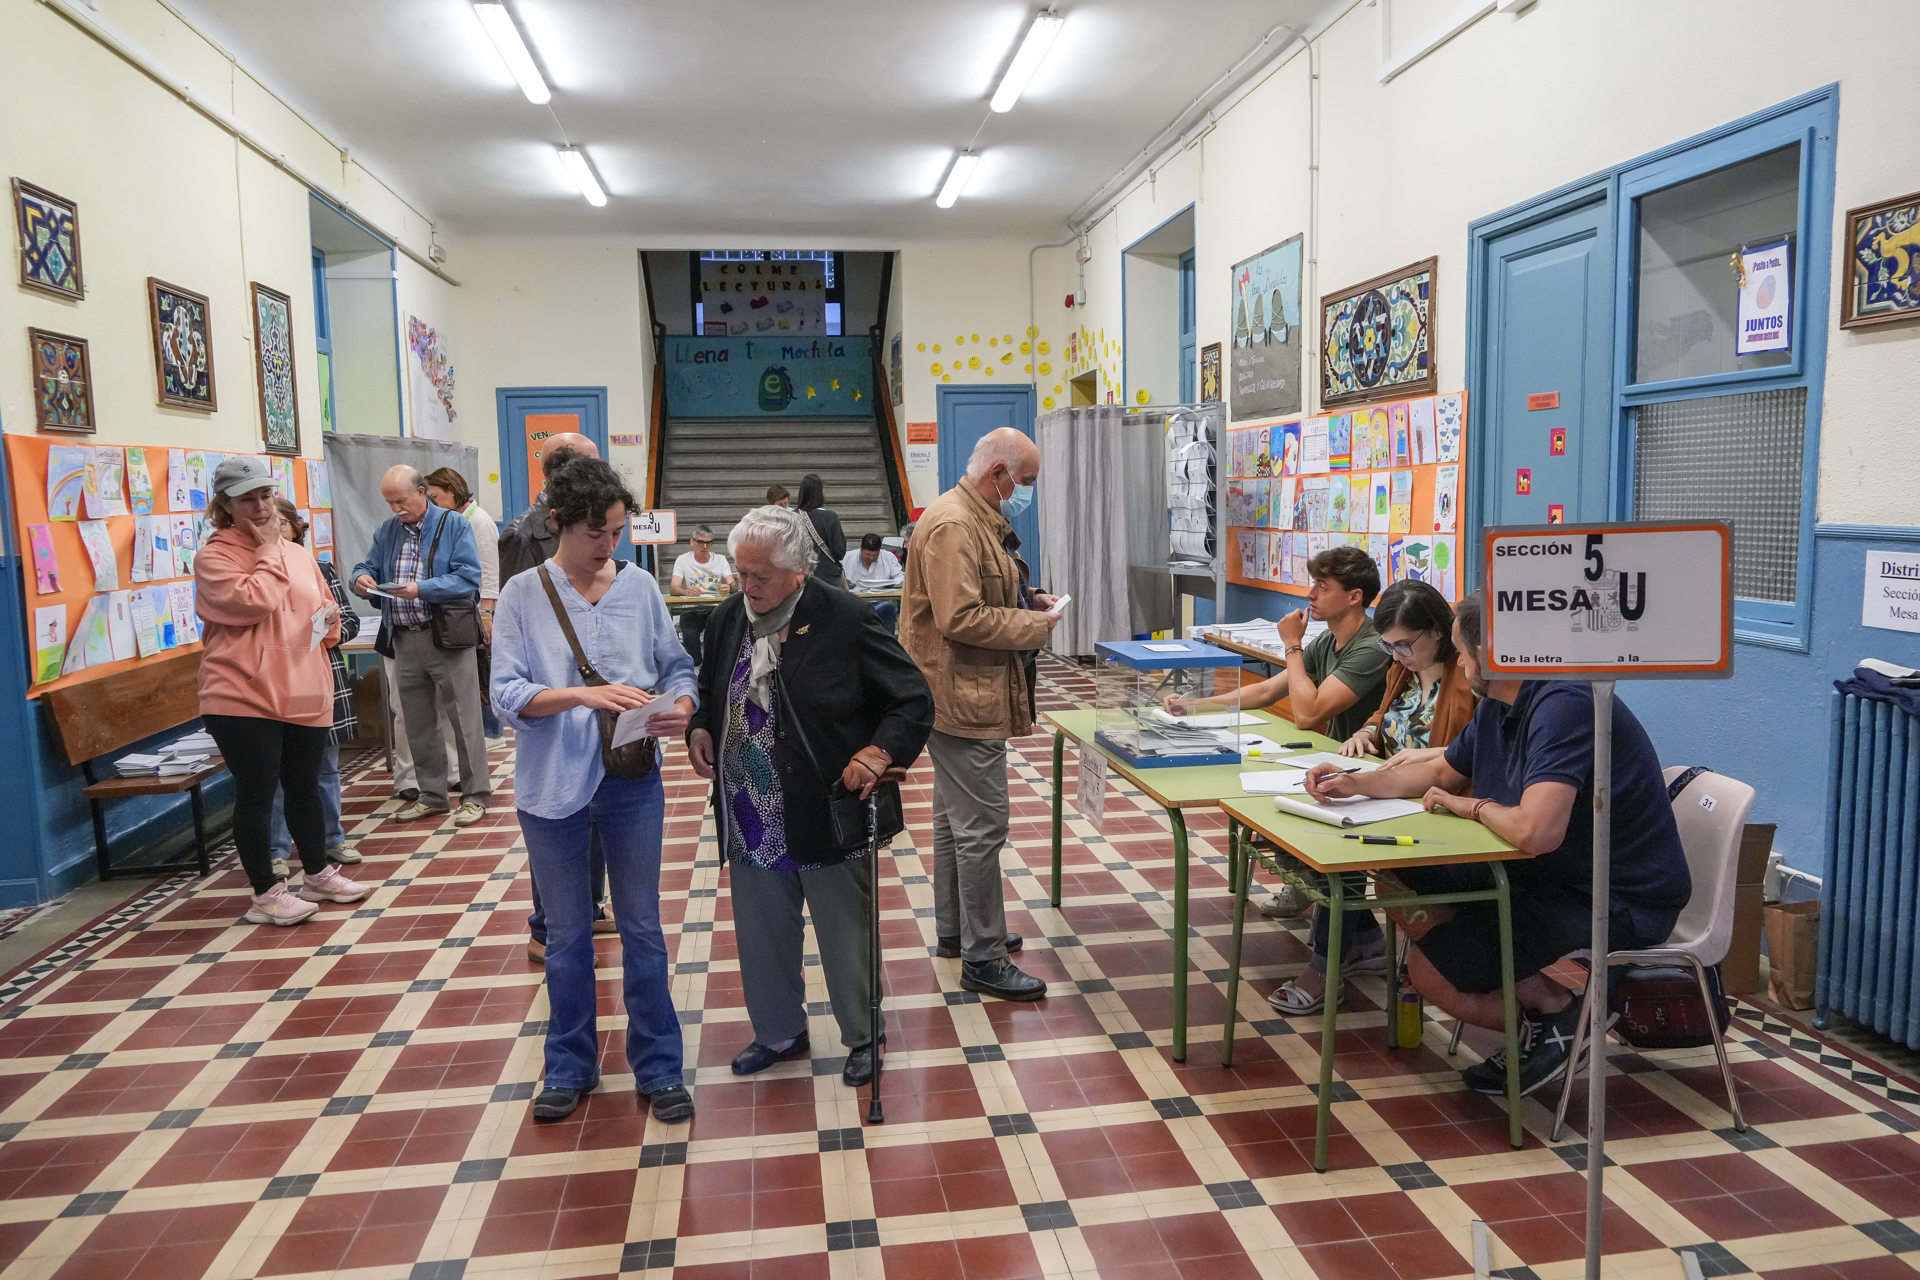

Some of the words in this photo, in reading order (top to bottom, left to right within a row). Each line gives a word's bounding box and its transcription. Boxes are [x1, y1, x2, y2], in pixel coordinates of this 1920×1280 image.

[720, 263, 797, 276] COLME
[702, 279, 823, 293] LECTURAS
[1745, 314, 1783, 332] JUNTOS
[648, 512, 655, 525] 9
[654, 522, 661, 534] U
[1496, 541, 1573, 557] SECCIÓN
[1583, 533, 1604, 582] 5
[1880, 561, 1920, 577] Distri
[1497, 588, 1594, 612] MESA
[1619, 572, 1647, 622] U
[1889, 605, 1918, 621] Mesa
[1500, 654, 1517, 664] De
[1519, 654, 1531, 664] la
[1534, 654, 1563, 664] letra
[1617, 655, 1626, 663] a
[1628, 653, 1640, 663] la
[1702, 798, 1713, 810] 31
